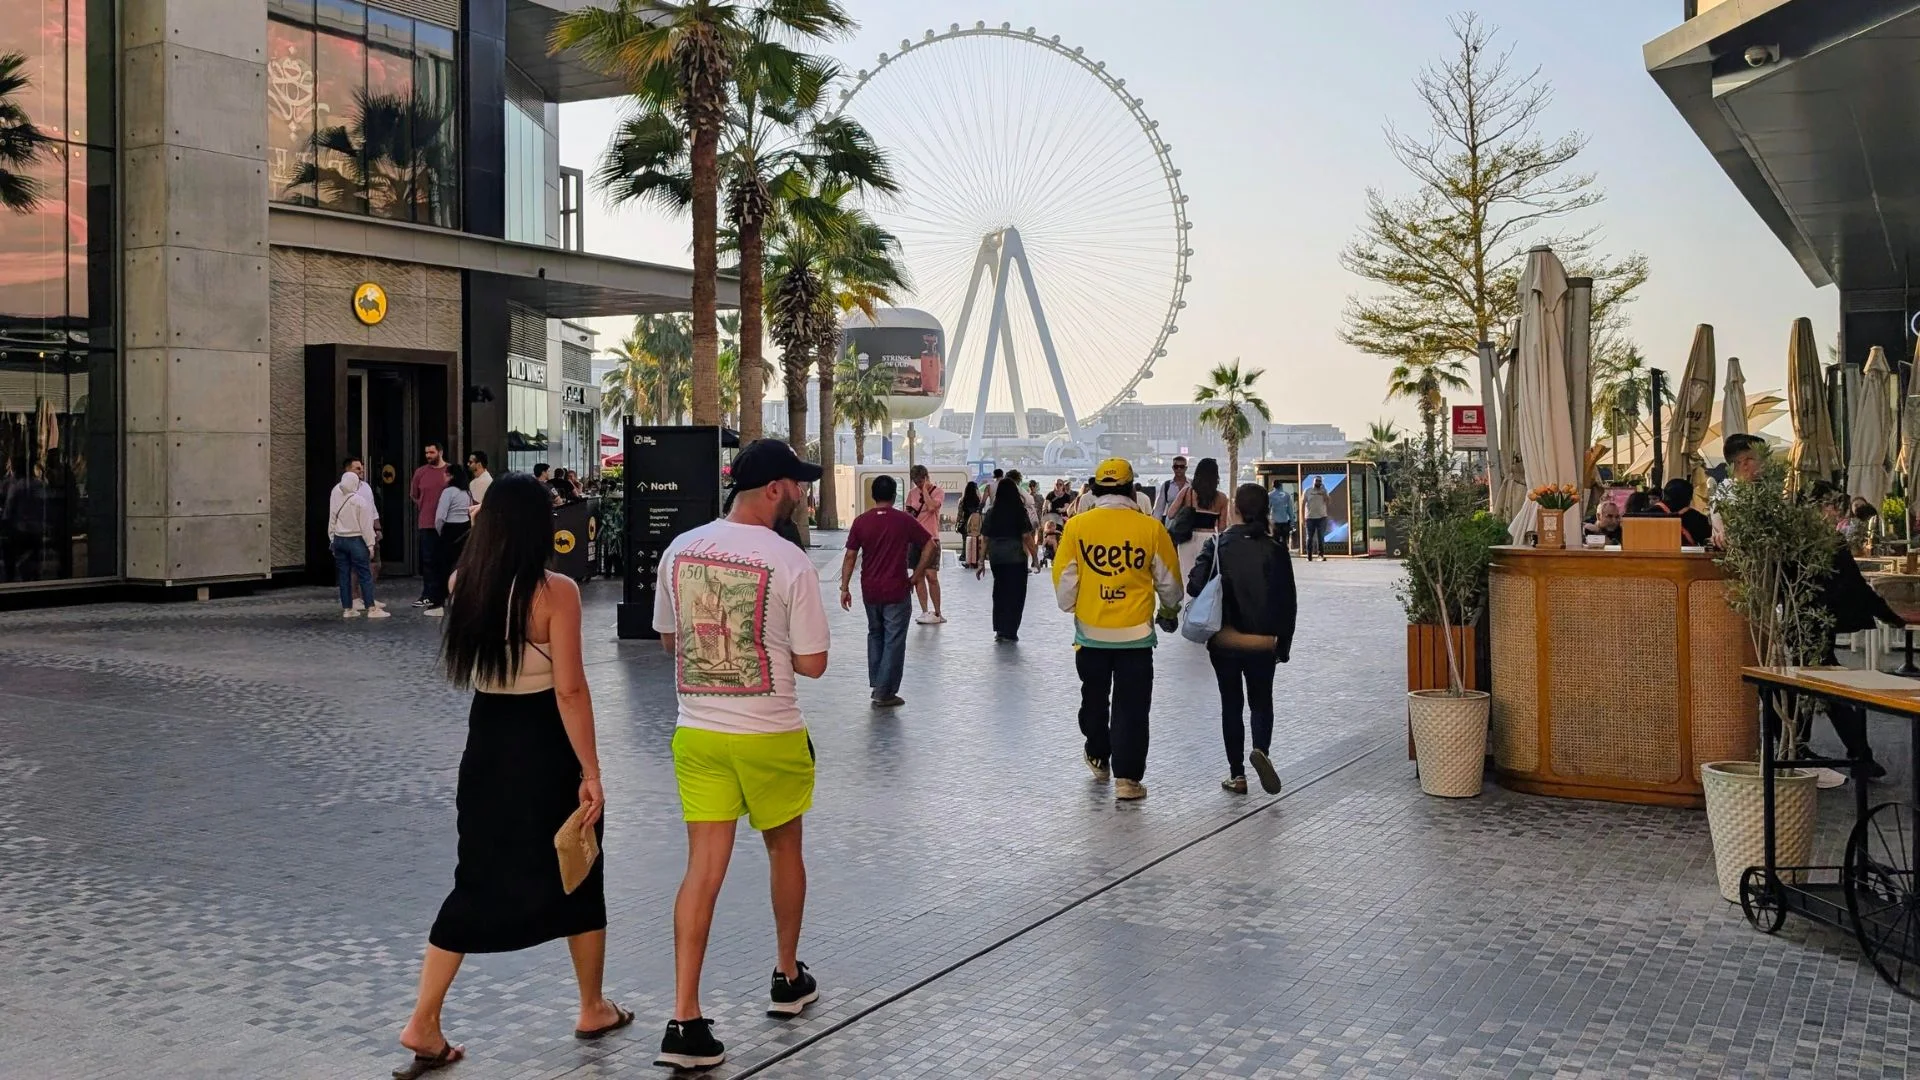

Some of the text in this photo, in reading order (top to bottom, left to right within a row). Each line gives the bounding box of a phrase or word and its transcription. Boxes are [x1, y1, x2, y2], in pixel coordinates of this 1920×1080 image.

[511, 360, 526, 381] WILD
[526, 363, 544, 384] WINGS
[651, 482, 678, 490] North
[1079, 539, 1146, 576] keeta
